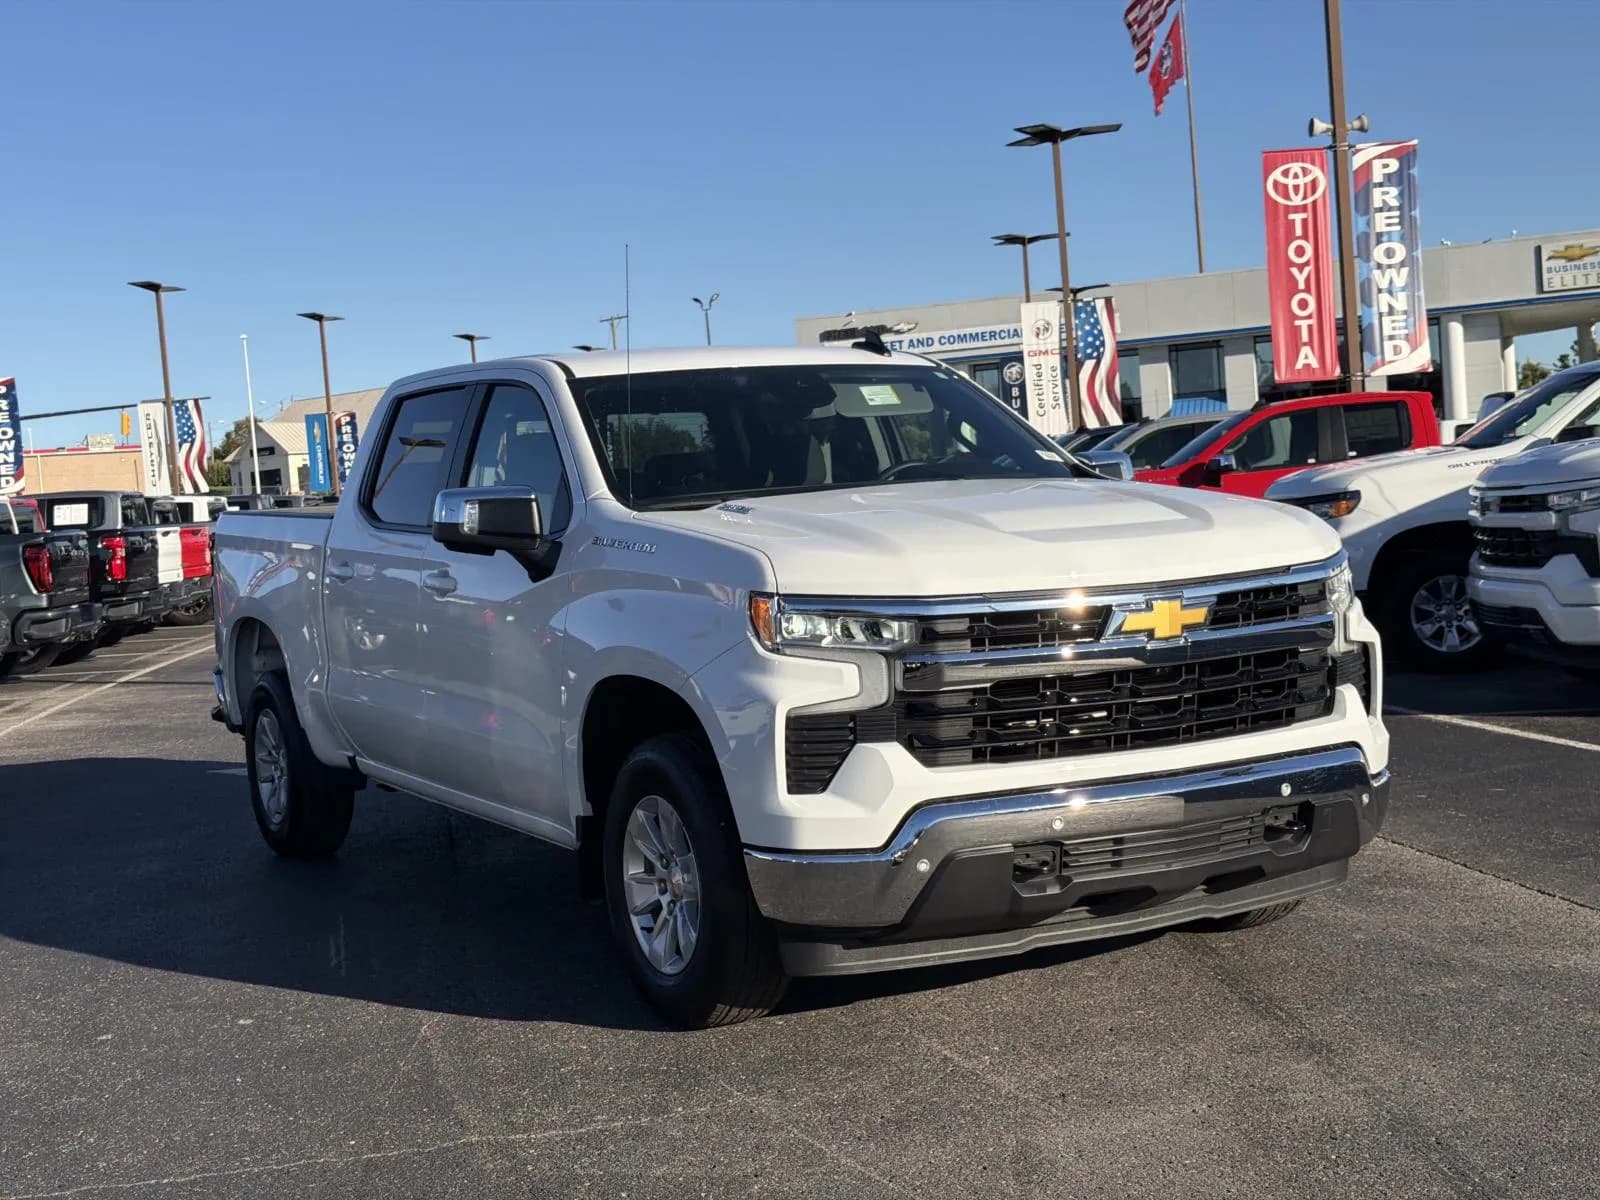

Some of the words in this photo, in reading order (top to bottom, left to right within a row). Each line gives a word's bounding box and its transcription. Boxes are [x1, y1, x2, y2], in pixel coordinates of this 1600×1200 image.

[1288, 213, 1319, 370] TOYOTA
[908, 337, 935, 349] AND
[1032, 363, 1046, 417] Certified
[1048, 365, 1061, 410] Service
